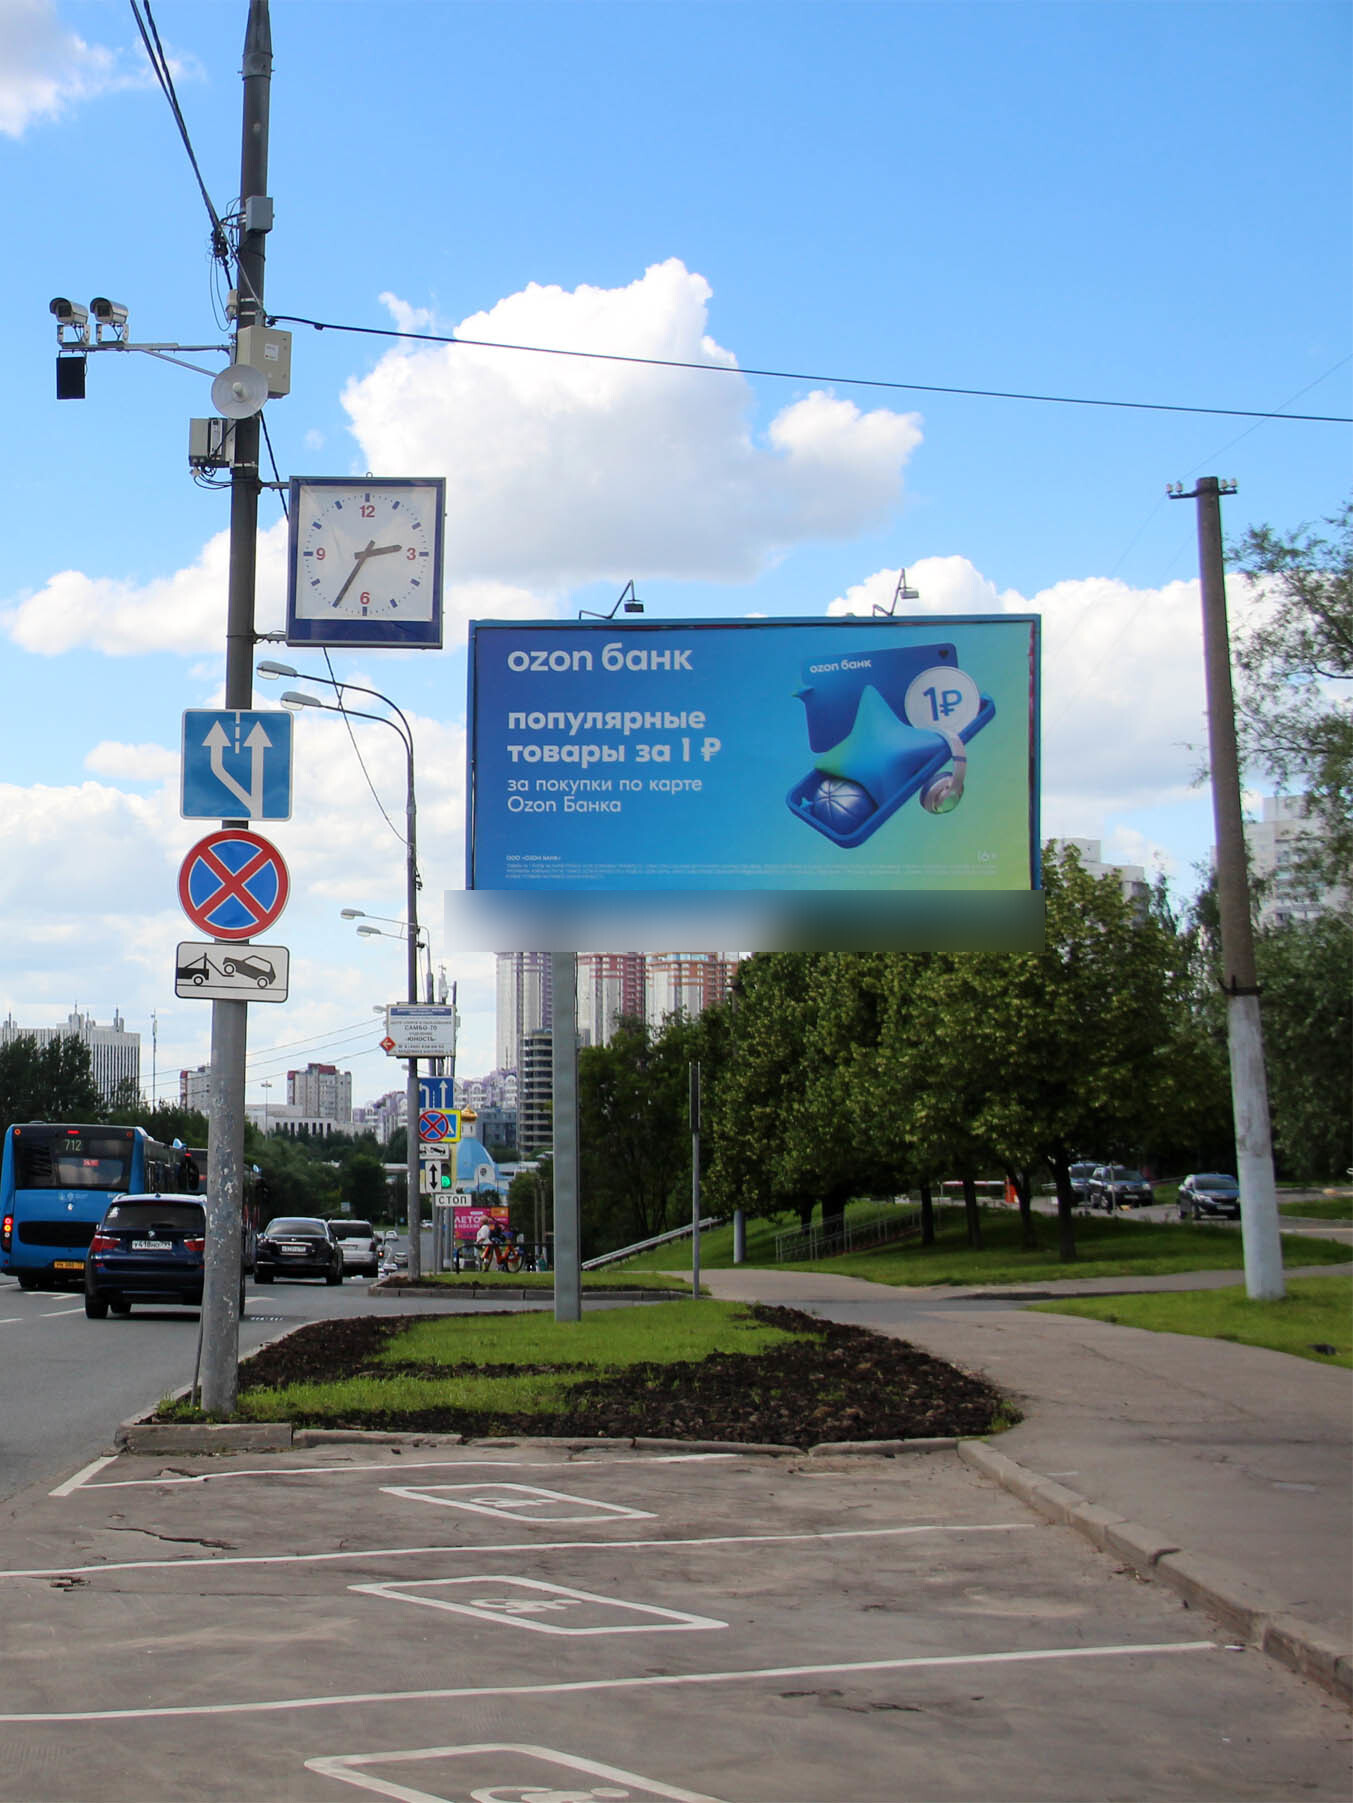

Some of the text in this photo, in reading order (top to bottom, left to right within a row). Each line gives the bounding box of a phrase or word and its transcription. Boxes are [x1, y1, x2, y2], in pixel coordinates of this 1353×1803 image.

[360, 505, 376, 518] 12
[316, 548, 326, 560] 9
[406, 548, 416, 560] 3
[360, 592, 370, 605] 6
[507, 642, 693, 672] ozon банк
[809, 658, 872, 674] ozon банк
[508, 710, 706, 736] популярные
[507, 744, 625, 769] товары
[635, 744, 671, 763] за
[681, 737, 691, 762] 1
[507, 779, 703, 795] за покупки по карте
[507, 796, 622, 813] Ozon Банка
[64, 1140, 82, 1152] 712
[438, 1196, 467, 1205] СТОП
